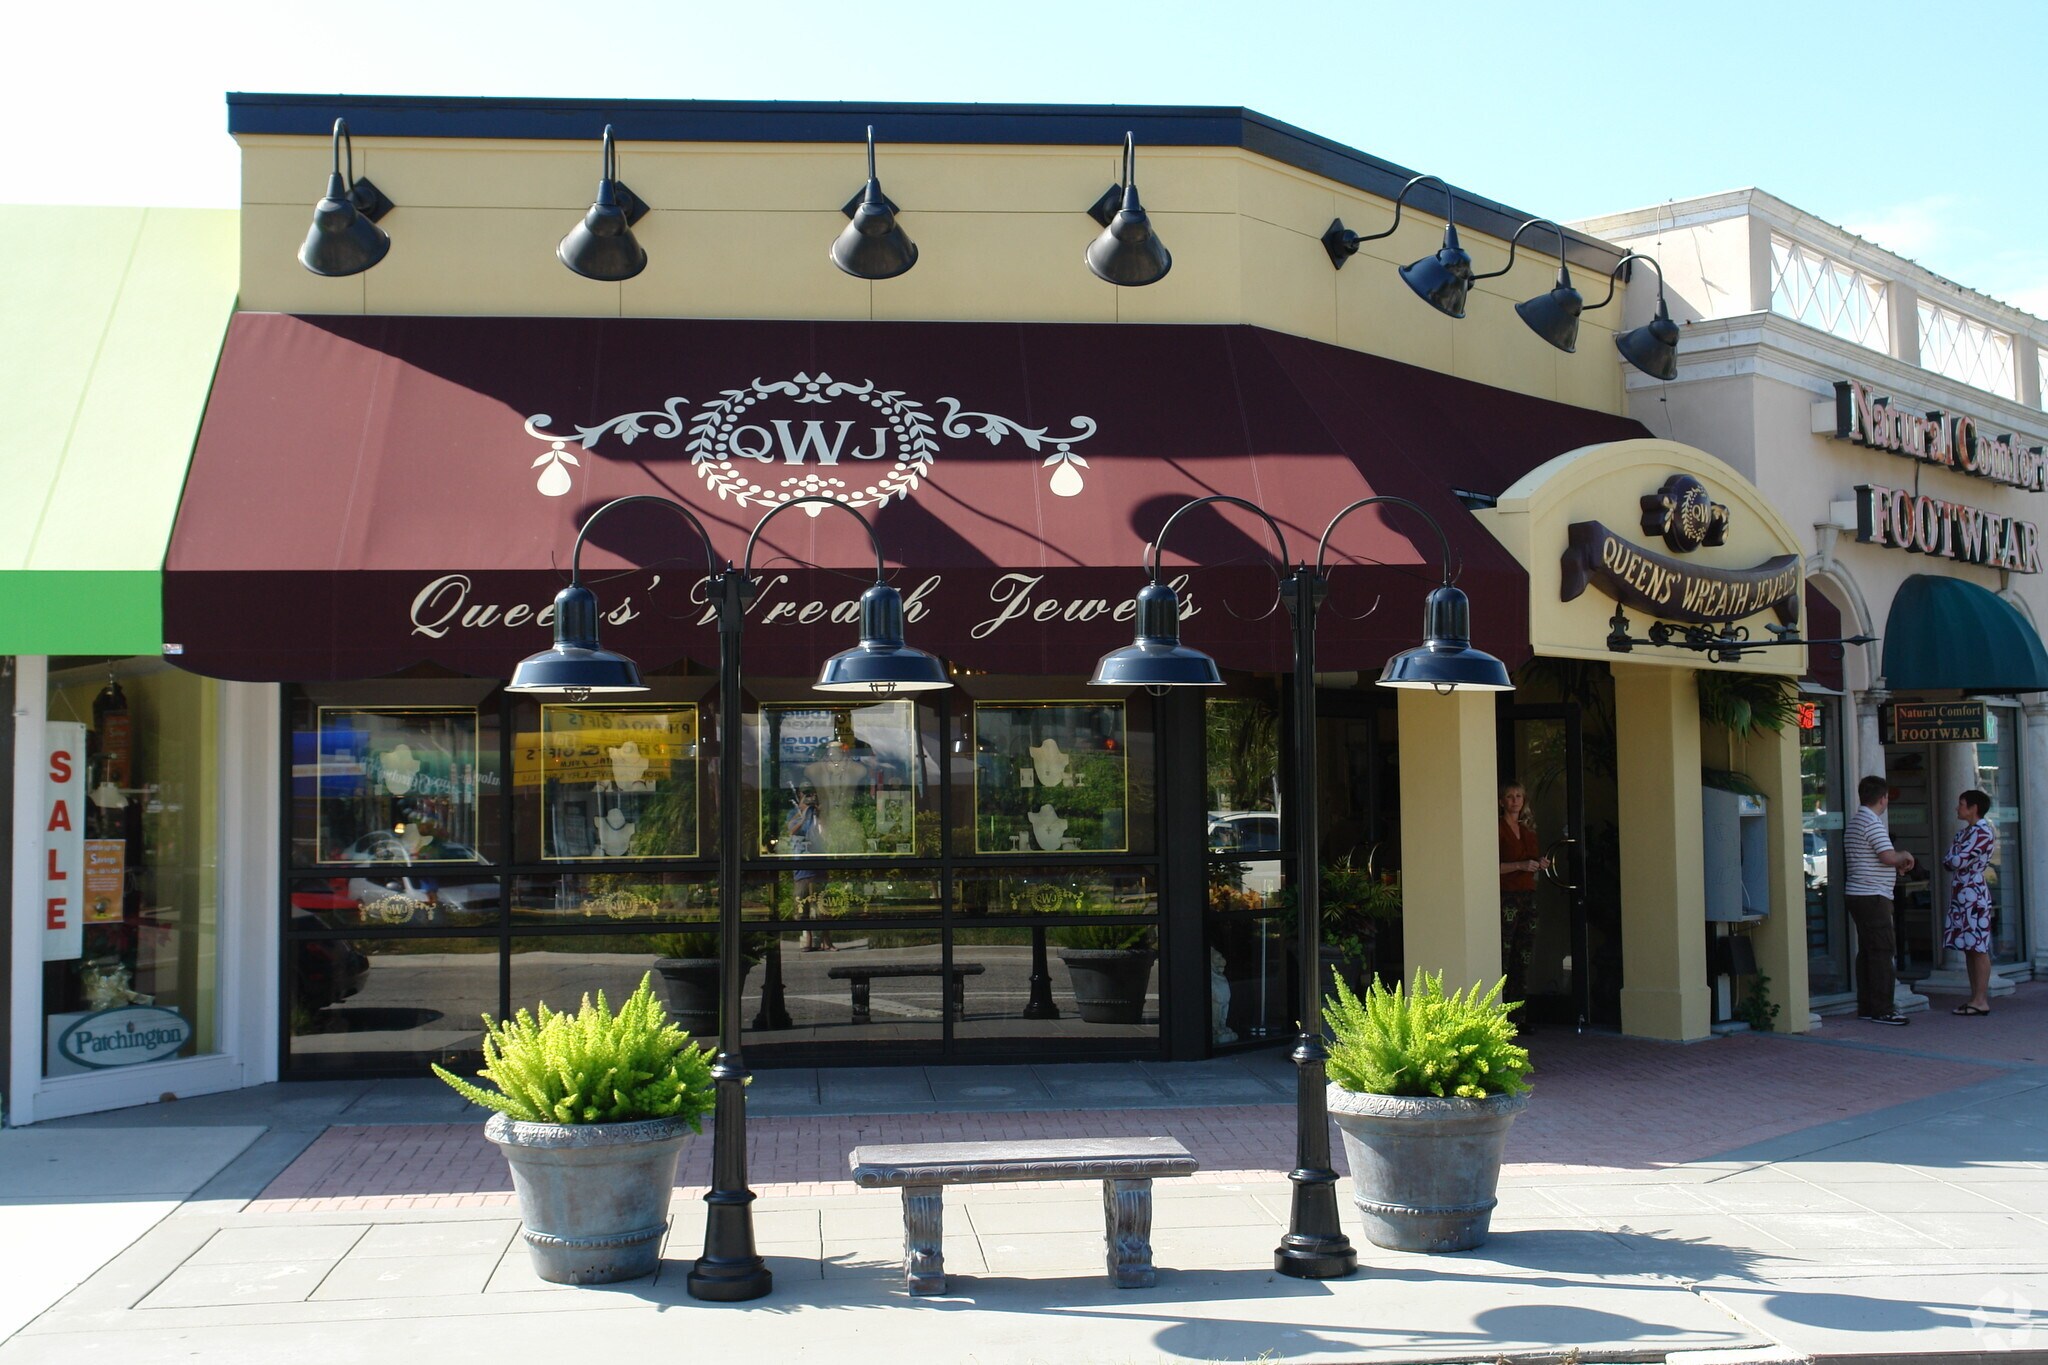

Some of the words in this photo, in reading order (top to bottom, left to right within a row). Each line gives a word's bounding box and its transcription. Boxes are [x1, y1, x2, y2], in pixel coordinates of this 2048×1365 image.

[728, 419, 890, 466] QWJ
[1846, 380, 1954, 466] Natural
[1868, 484, 2043, 574] FOOTWEAR
[410, 573, 661, 639] Quees'
[690, 574, 941, 626] Wreah
[1602, 536, 1682, 605] QUEENS'
[1681, 575, 1751, 617] WREATH
[1750, 566, 1797, 612] JEWELS
[1899, 707, 1937, 718] Natural
[1939, 704, 1981, 717] Comfort
[1901, 727, 1981, 741] FOOTWEAR
[47, 750, 72, 930] SALE
[74, 1025, 183, 1055] Patchington
